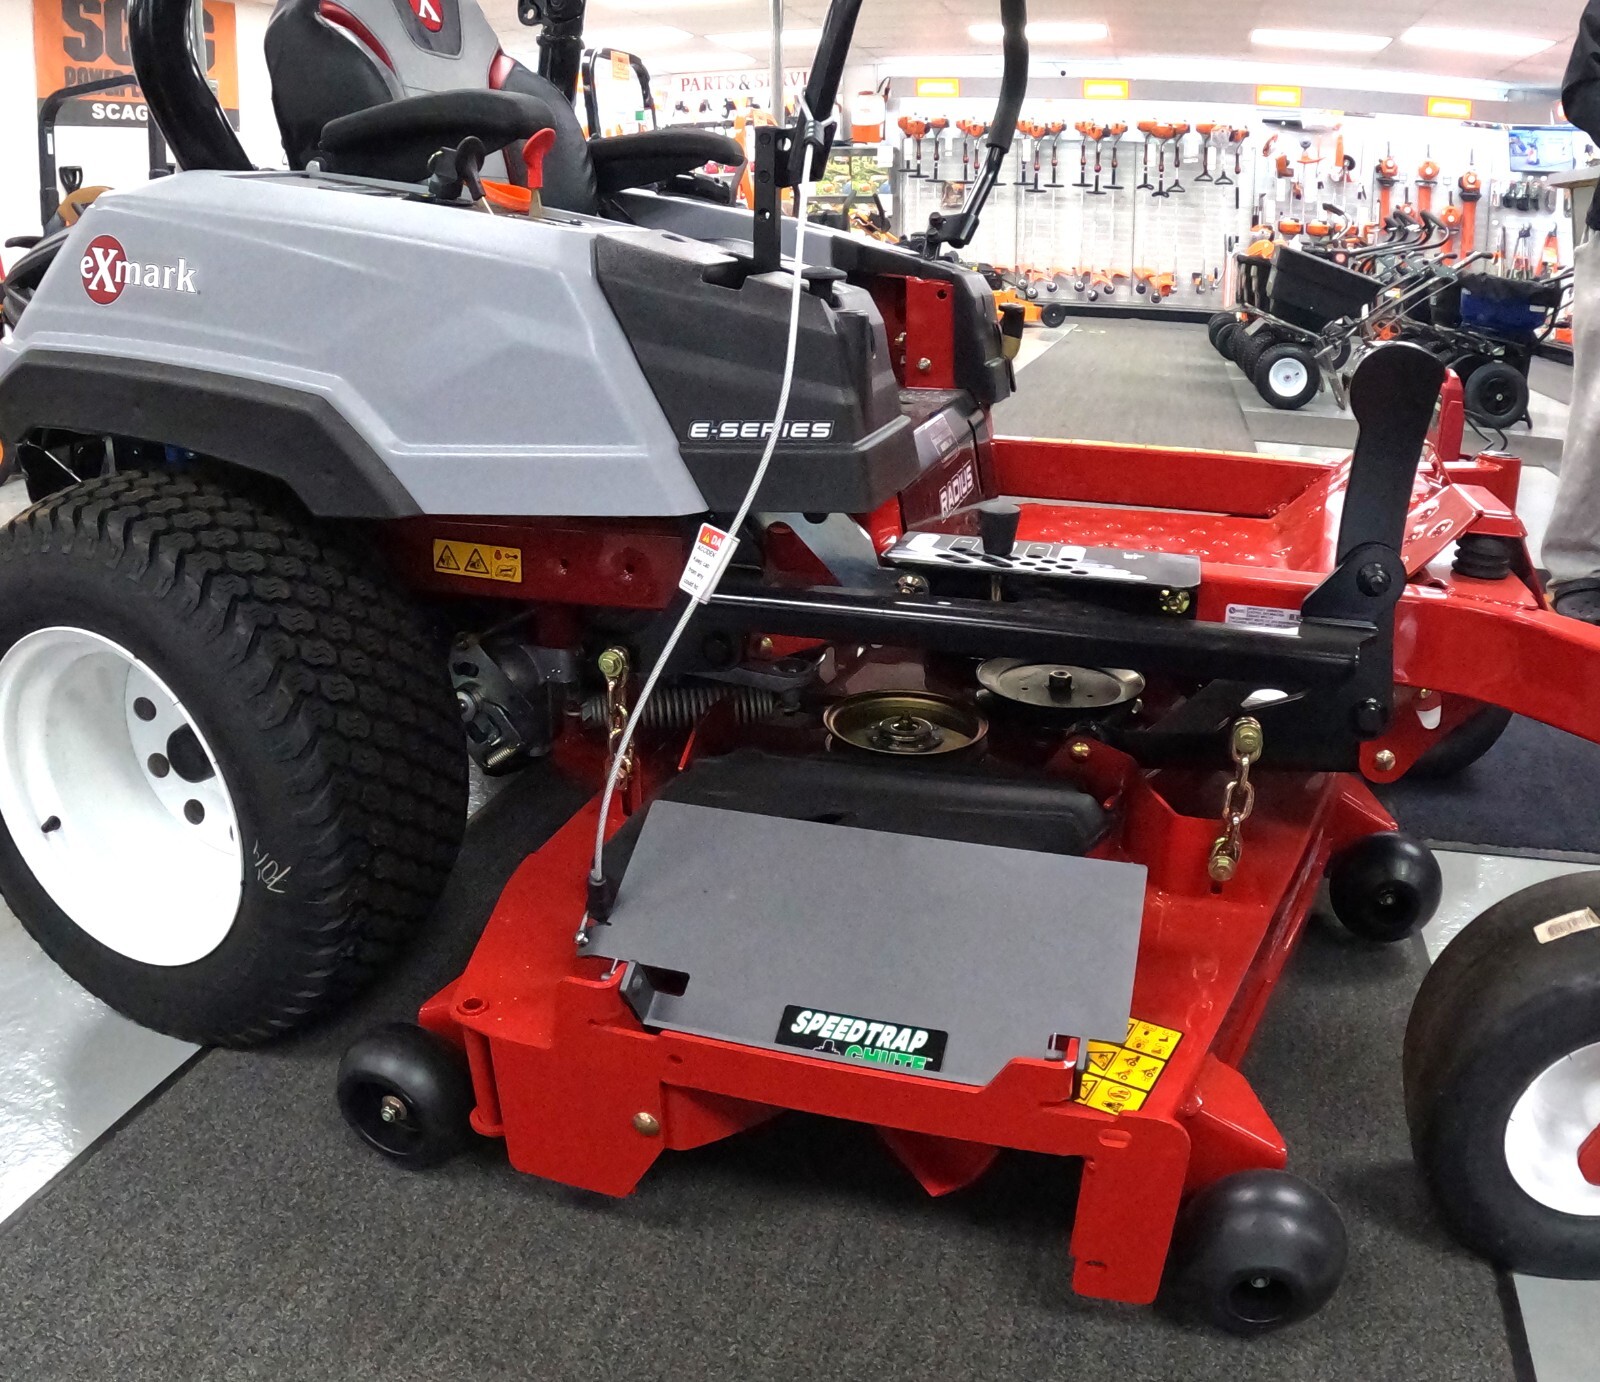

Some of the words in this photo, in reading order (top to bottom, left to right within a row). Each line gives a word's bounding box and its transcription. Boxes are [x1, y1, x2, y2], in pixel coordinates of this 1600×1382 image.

[681, 75, 735, 92] PARTS
[738, 73, 750, 91] &
[91, 103, 149, 121] SCAG
[80, 246, 197, 293] eXmark
[690, 422, 831, 438] E-SERIES
[939, 463, 975, 520] RADIUS
[790, 1010, 929, 1053] SPEEDTRAP
